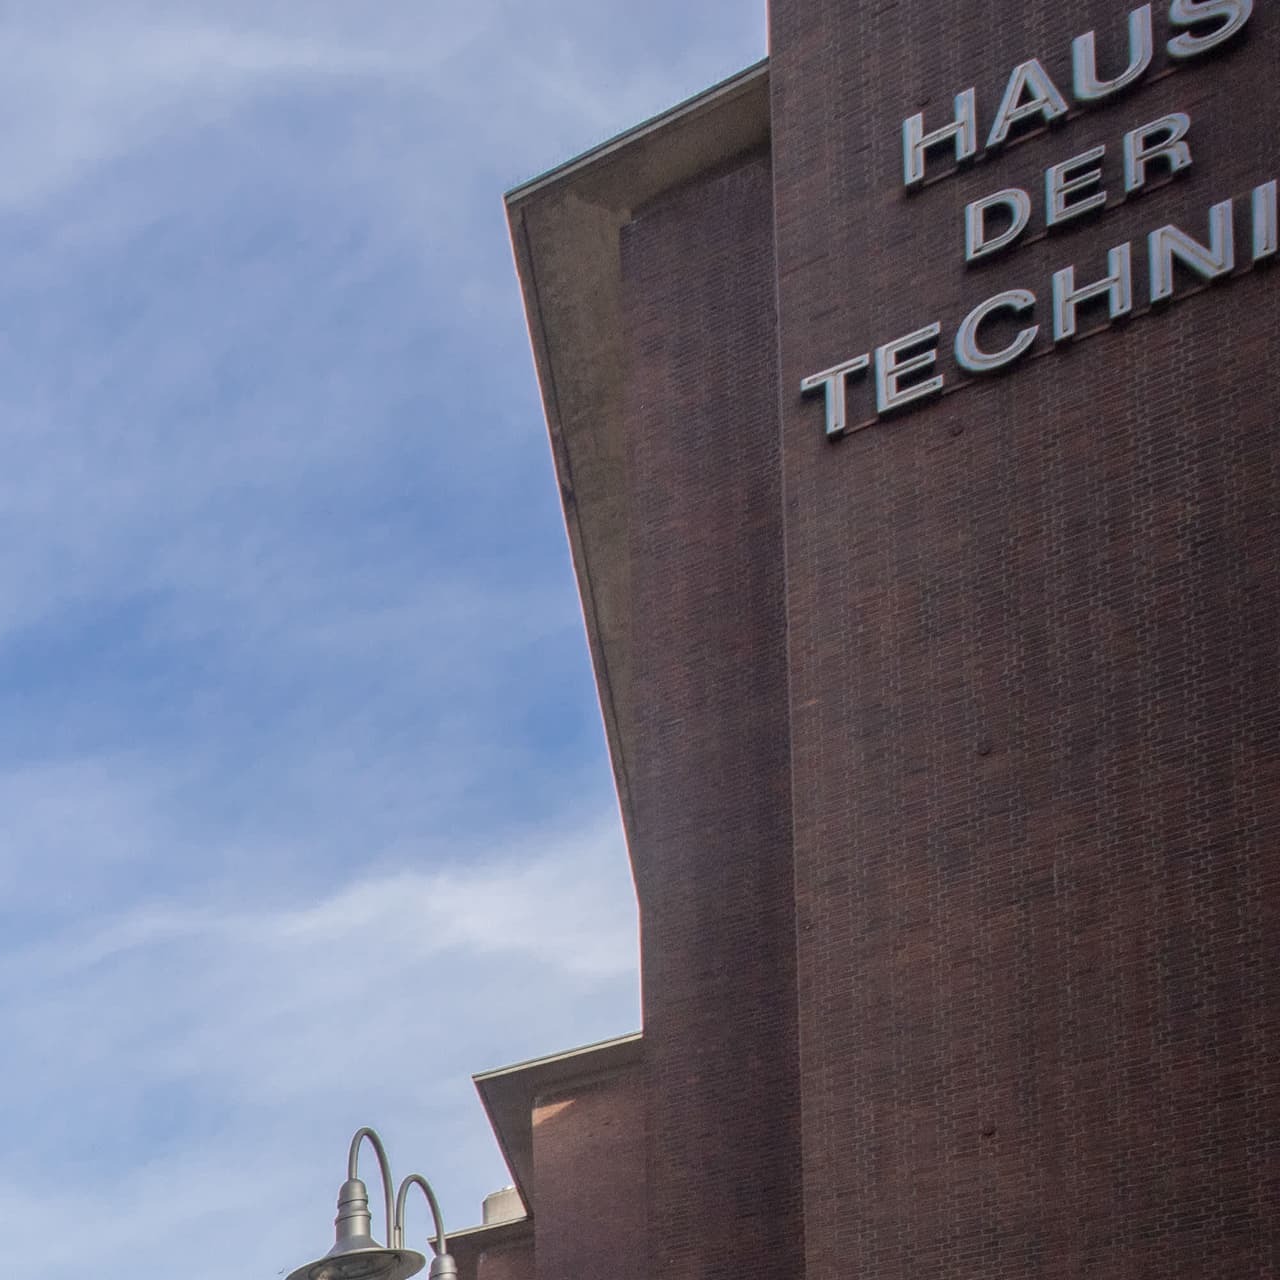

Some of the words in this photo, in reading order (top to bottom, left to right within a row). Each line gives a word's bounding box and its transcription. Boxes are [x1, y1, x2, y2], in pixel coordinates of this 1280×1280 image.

[903, 0, 1254, 188] HAUS
[965, 112, 1193, 263] DER
[800, 178, 1279, 436] TECHNI
